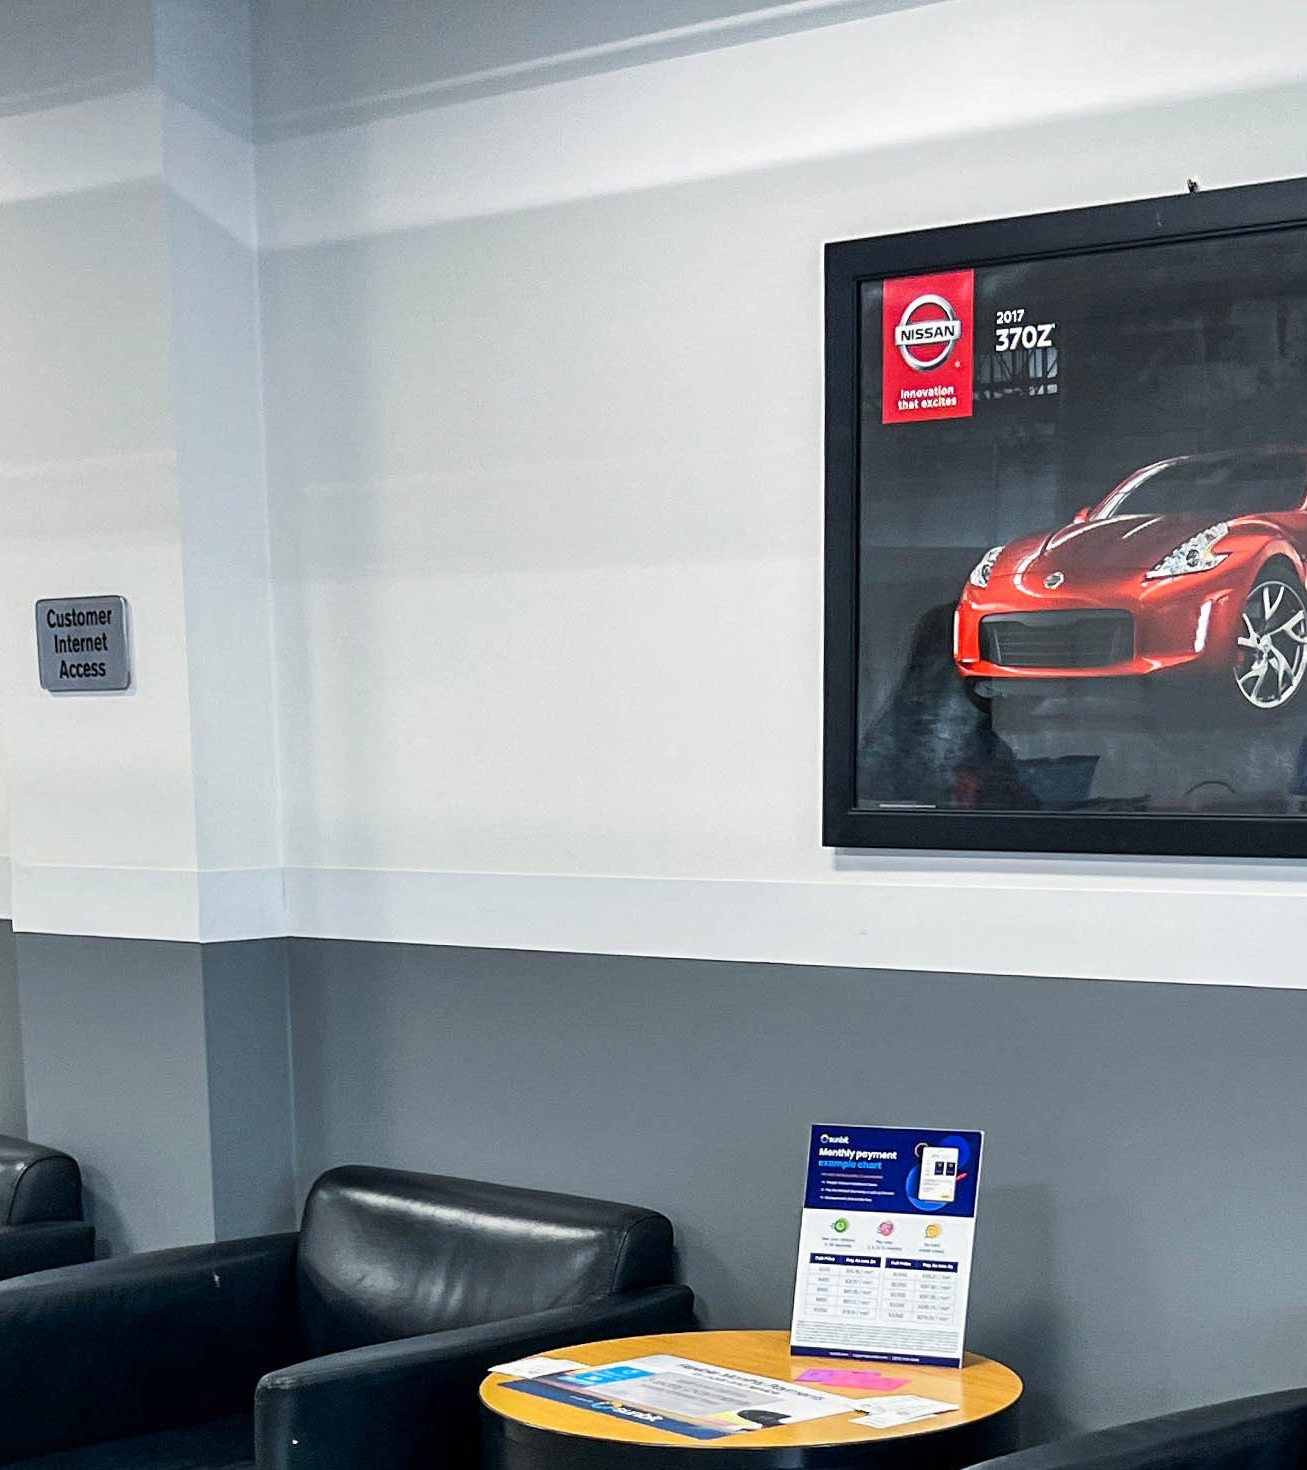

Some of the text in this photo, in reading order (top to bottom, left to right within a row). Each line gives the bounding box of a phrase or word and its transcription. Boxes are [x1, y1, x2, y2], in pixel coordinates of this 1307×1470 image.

[996, 309, 1024, 324] 2017
[901, 325, 955, 341] NISSAN
[995, 324, 1053, 351] 370Z
[901, 386, 954, 399] Innovation
[898, 397, 957, 410] that excites
[47, 608, 112, 628] Customer
[54, 633, 107, 653] Internet
[59, 660, 106, 679] Access
[819, 1148, 897, 1160] Monthly payment
[858, 1161, 882, 1169] chart
